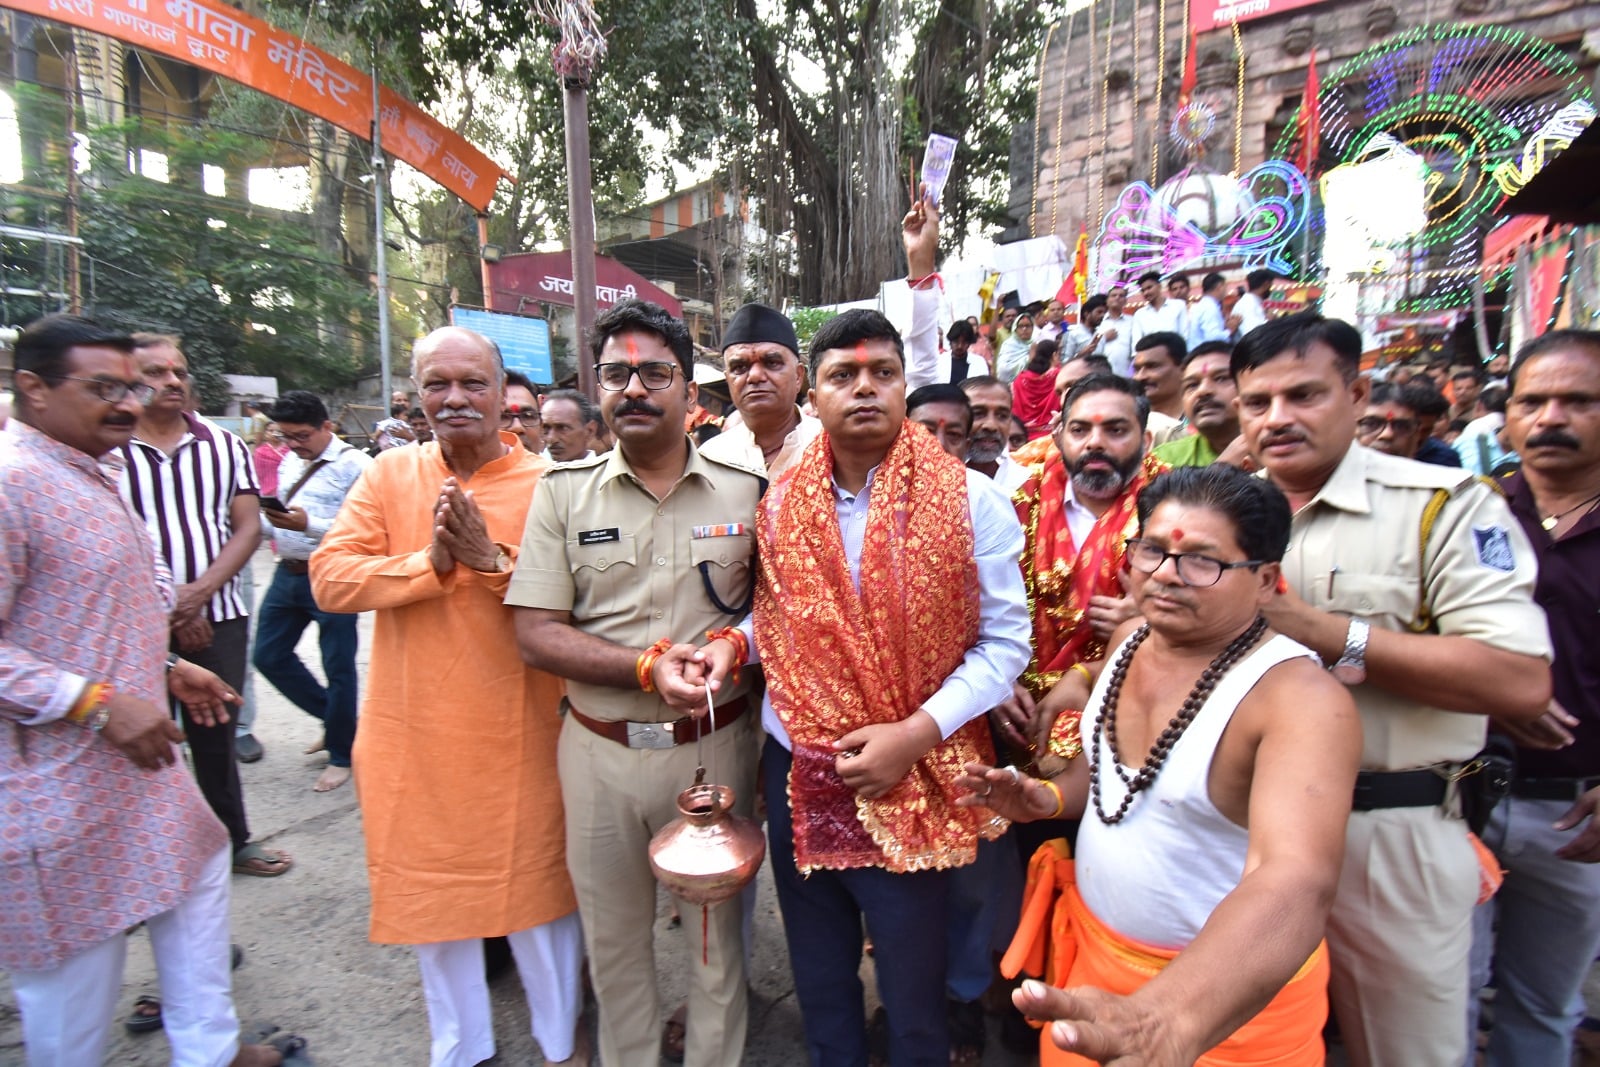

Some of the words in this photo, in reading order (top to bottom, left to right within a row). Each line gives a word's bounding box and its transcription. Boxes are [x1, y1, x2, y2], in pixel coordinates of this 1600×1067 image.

[165, 0, 256, 53] माता
[267, 38, 360, 107] मंदिर
[186, 34, 231, 65] द्वार
[538, 275, 575, 296] जय
